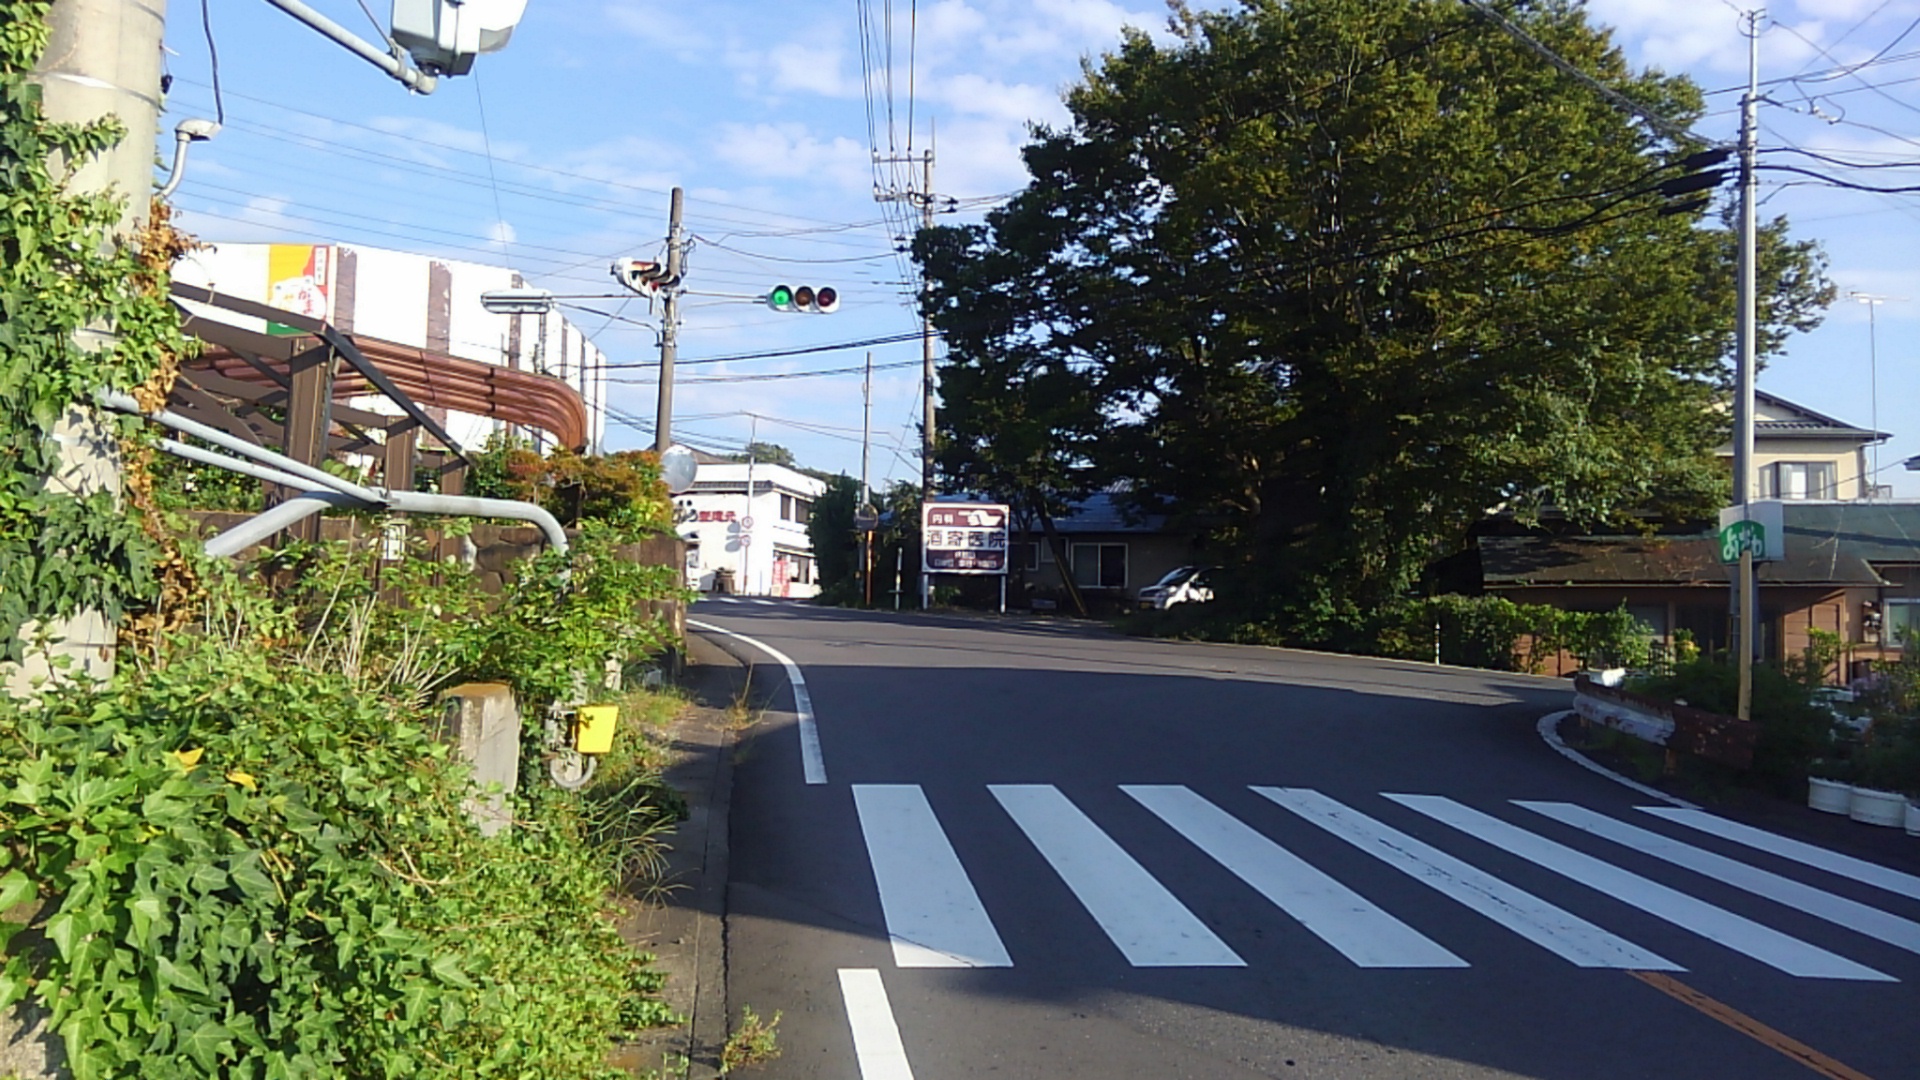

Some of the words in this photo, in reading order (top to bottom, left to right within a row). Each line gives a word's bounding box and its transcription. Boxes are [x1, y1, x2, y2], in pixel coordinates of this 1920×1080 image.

[931, 513, 954, 525] 内科
[926, 529, 1006, 549] 酒寄医院
